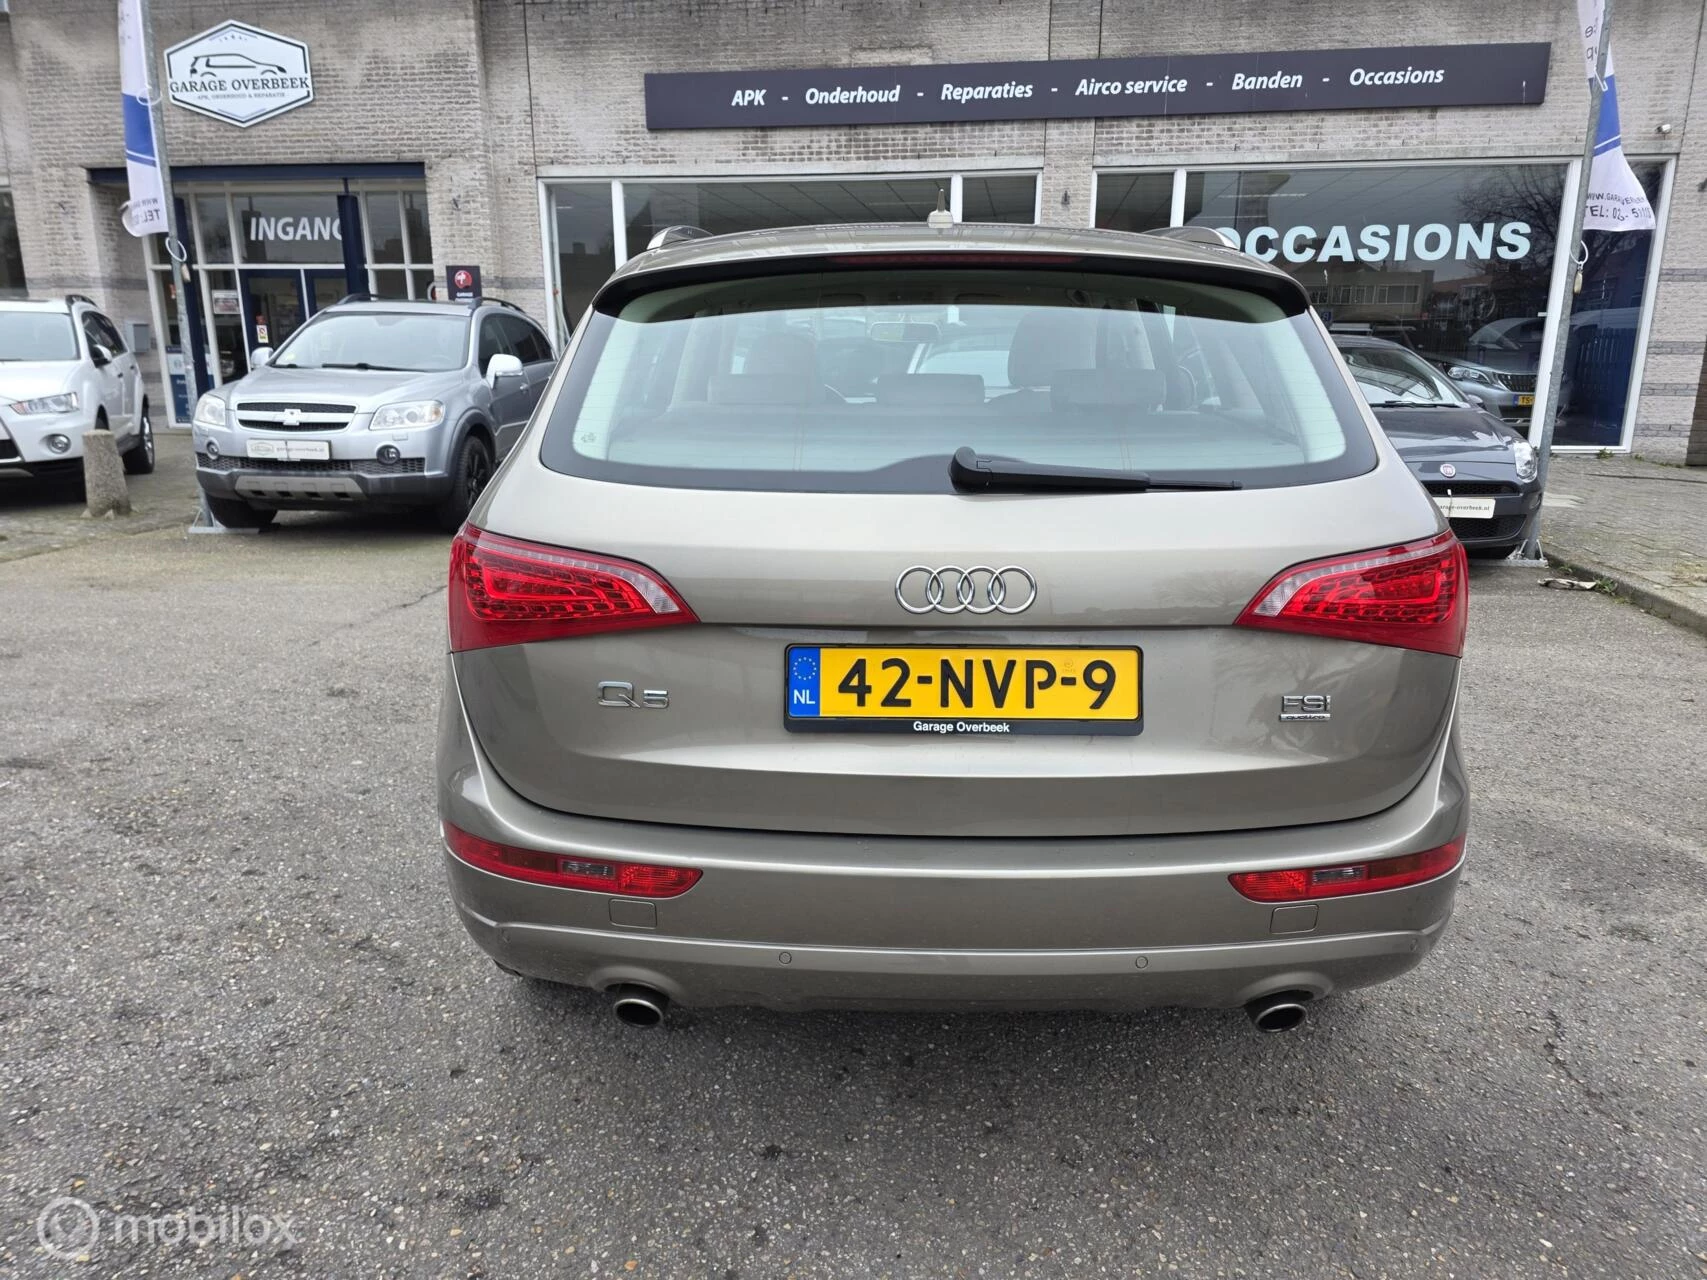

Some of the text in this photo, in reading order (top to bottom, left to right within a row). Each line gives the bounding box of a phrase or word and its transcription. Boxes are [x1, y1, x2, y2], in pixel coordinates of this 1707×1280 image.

[169, 77, 310, 93] GARAGE OVERBEEK
[731, 89, 767, 106] APK
[805, 84, 901, 104] Onderhoud
[941, 81, 1033, 103] Reparaties
[1075, 78, 1122, 96] Airco
[1124, 75, 1188, 95] service
[1232, 70, 1303, 91] Banden
[1349, 66, 1445, 86] Occasions
[1585, 204, 1609, 218] EL:
[837, 657, 1116, 710] 42-NVP-9
[598, 681, 668, 709] Q5
[793, 689, 816, 705] NL
[913, 721, 1010, 734] Garage Overbeek
